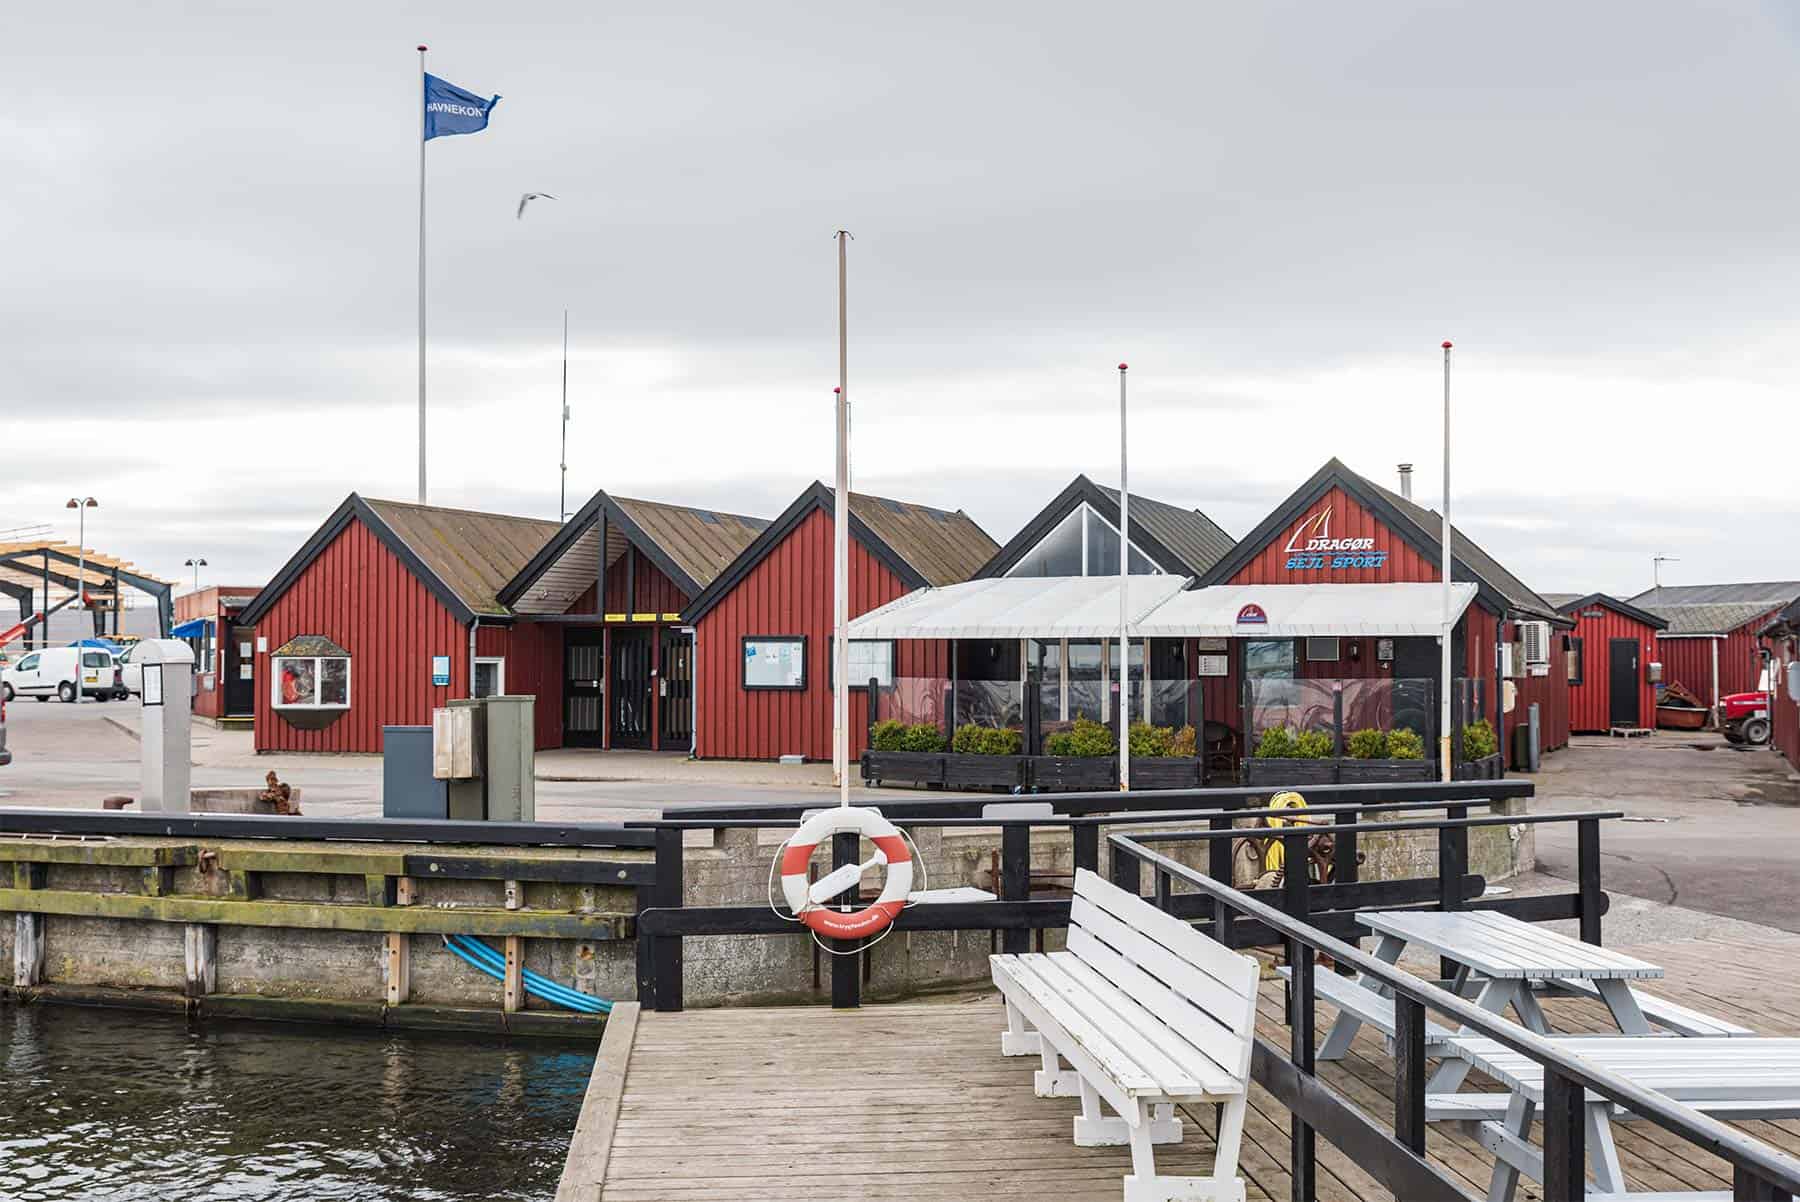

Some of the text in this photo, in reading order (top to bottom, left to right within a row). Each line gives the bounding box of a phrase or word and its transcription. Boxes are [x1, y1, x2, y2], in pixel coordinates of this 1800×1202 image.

[1305, 538, 1375, 551] DRAGØR
[1285, 556, 1387, 569] SEJL SPORT
